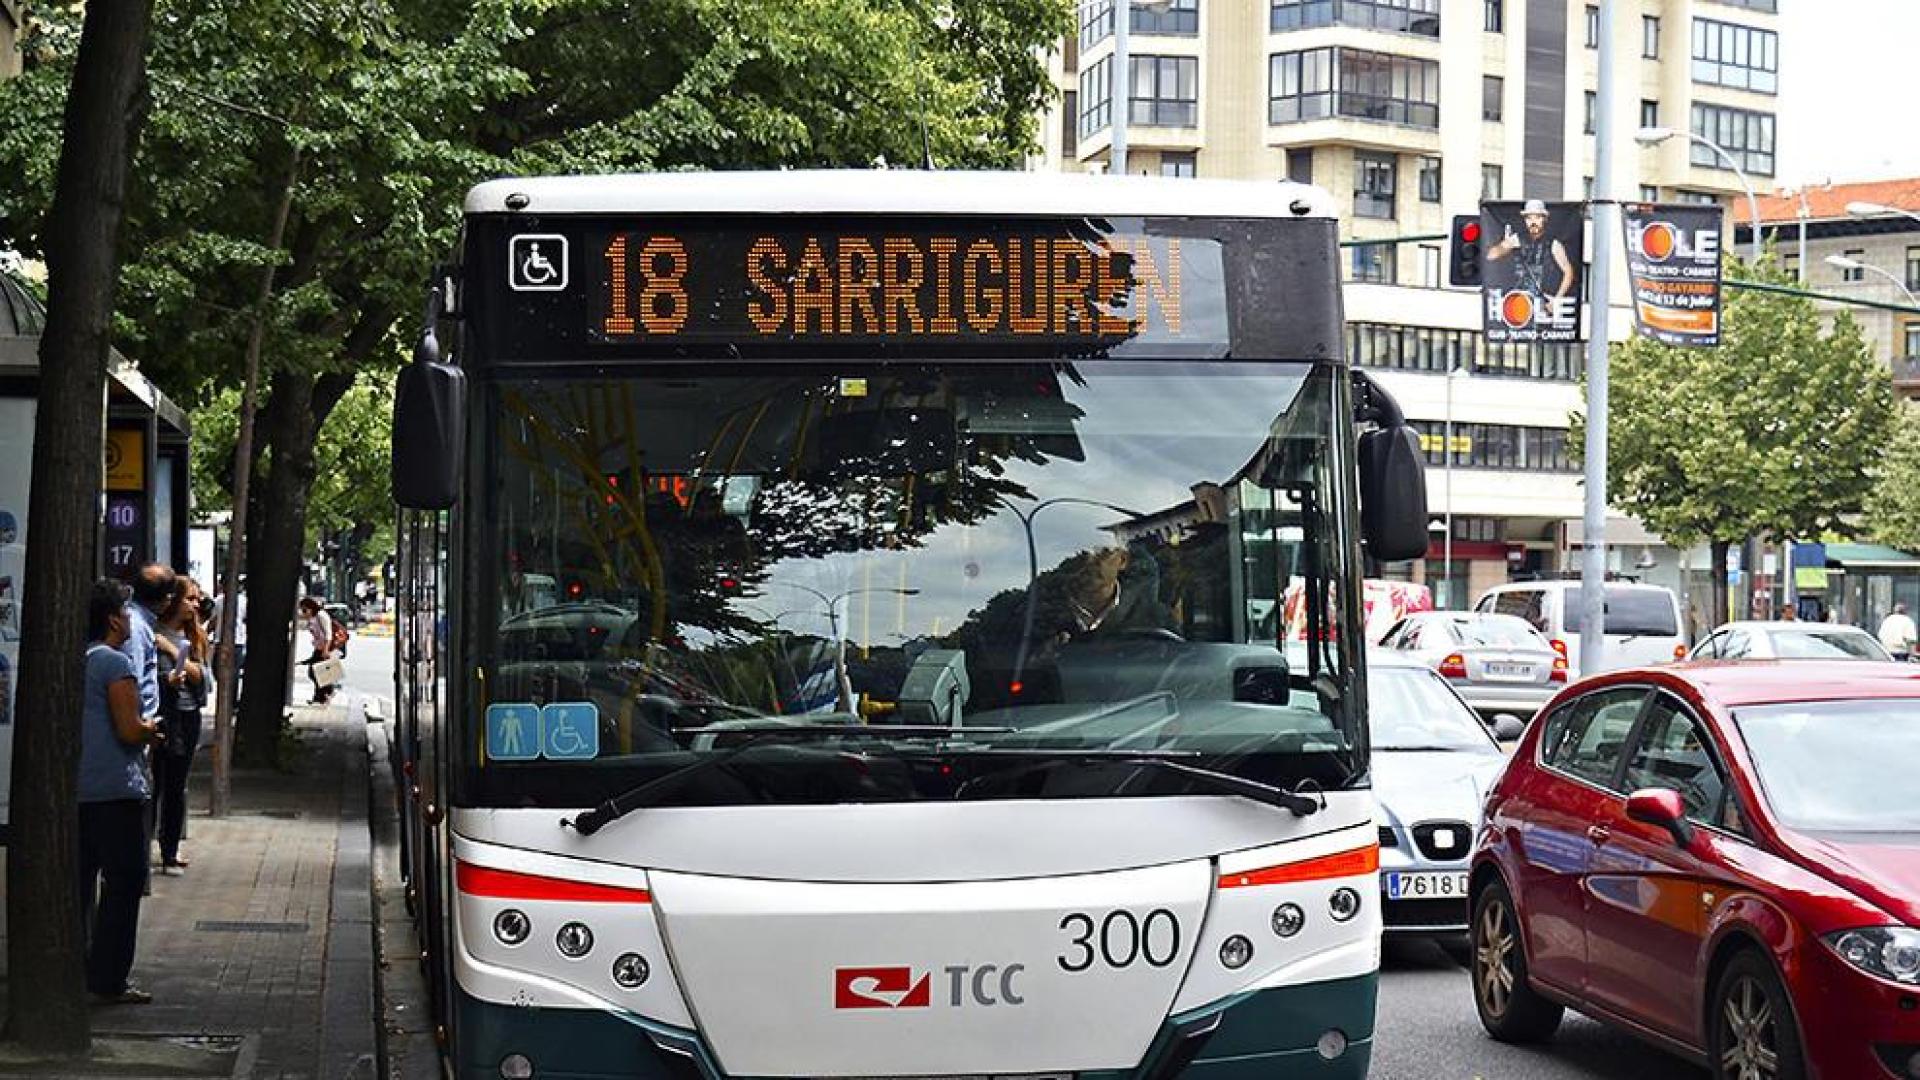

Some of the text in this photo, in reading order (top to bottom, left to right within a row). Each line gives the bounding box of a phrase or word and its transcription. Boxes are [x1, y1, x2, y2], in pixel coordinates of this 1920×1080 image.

[1626, 221, 1719, 261] HOLE
[604, 237, 1180, 334] 18 SARRIGUREN
[1487, 290, 1576, 329] HOLE
[111, 505, 135, 526] 10
[110, 544, 133, 565] 17
[1401, 875, 1454, 895] 7618
[1058, 908, 1181, 972] 300
[944, 964, 1025, 1007] TCC
